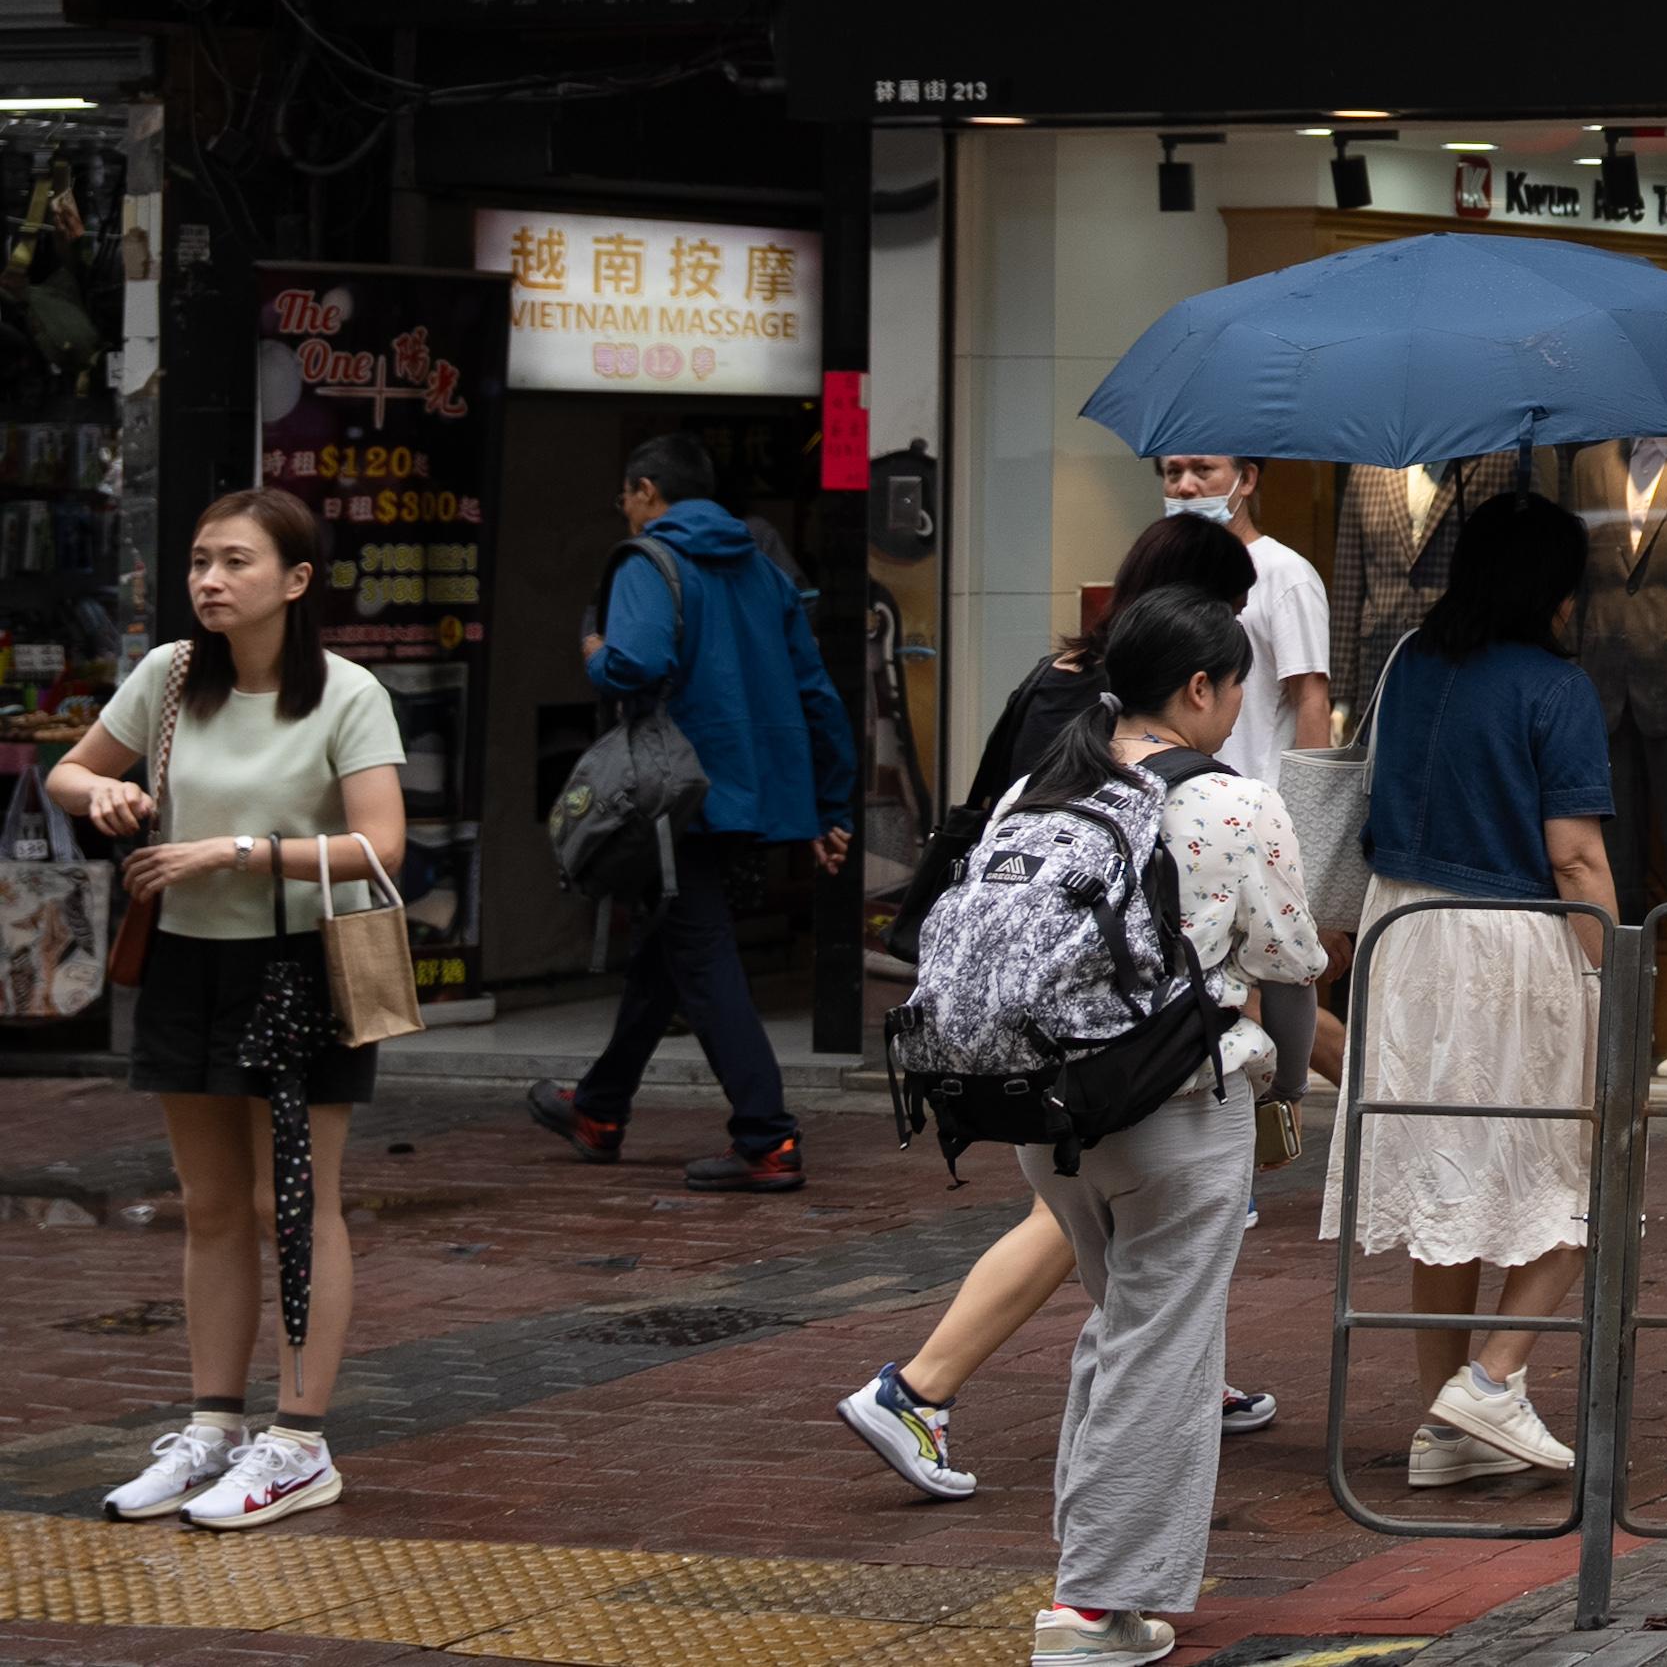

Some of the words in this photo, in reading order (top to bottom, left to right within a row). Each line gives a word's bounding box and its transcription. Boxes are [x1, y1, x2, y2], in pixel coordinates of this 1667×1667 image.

[1505, 170, 1580, 217] Kwun
[511, 226, 796, 305] 越南按摩
[276, 288, 342, 336] The
[511, 300, 651, 333] VIETNAM
[659, 307, 796, 340] MASSAGE
[301, 341, 374, 384] One
[985, 872, 1031, 884] GREGORY
